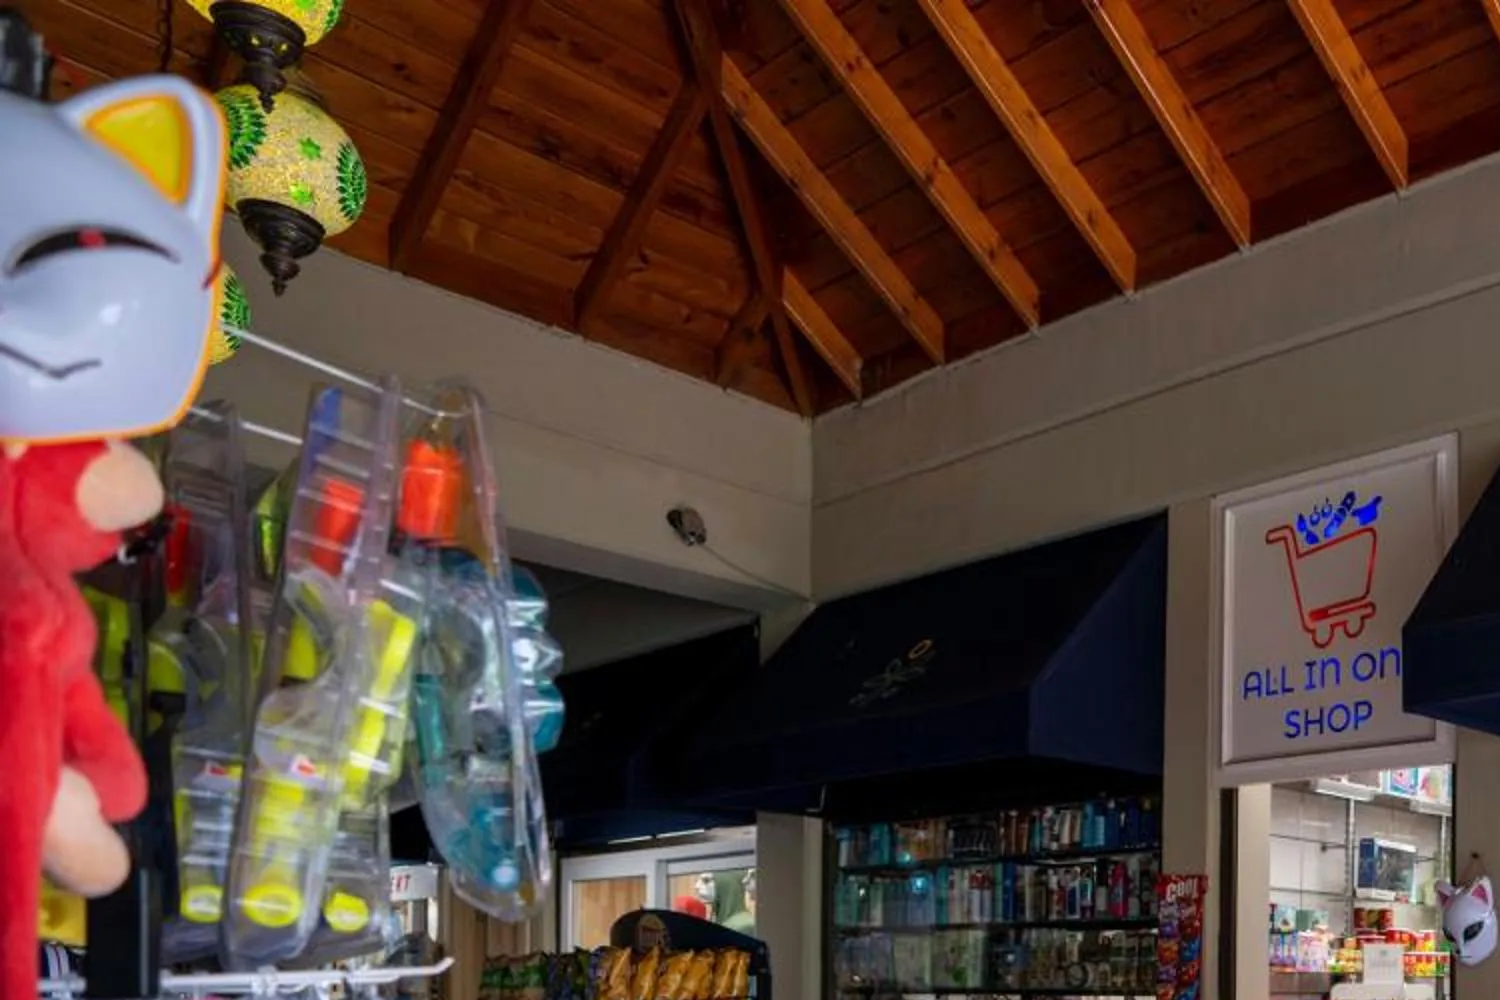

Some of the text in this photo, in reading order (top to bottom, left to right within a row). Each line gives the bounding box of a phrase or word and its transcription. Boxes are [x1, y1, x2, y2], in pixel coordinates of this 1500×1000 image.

[1243, 665, 1294, 700] ALL
[1351, 646, 1401, 682] ON
[1283, 700, 1374, 739] SHOP
